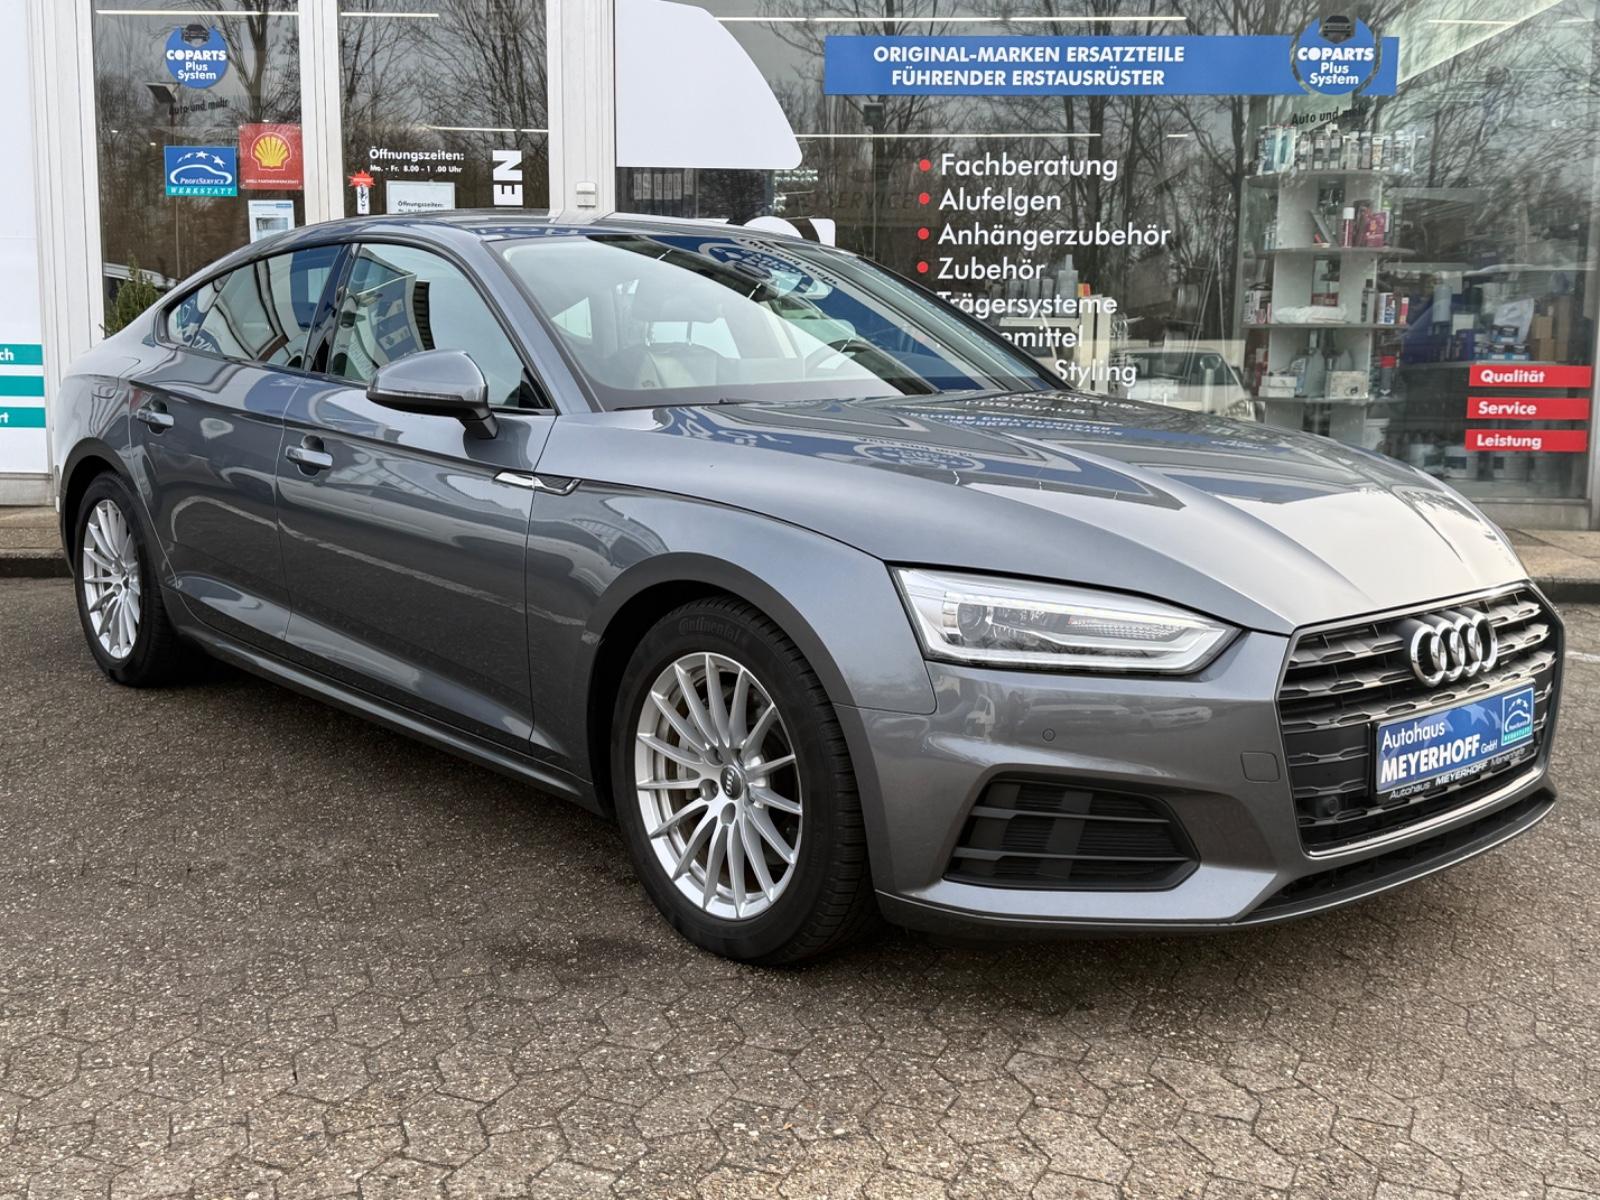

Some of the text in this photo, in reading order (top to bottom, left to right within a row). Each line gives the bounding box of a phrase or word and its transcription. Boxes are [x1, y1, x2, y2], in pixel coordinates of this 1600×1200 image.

[166, 49, 227, 61] COPARTS
[873, 46, 1185, 63] ORIGINAL-MARKEN ERSATZTEILE
[1297, 47, 1375, 61] COPARTS
[185, 61, 208, 71] Plus
[1320, 62, 1349, 73] Plus
[177, 69, 216, 82] System
[892, 66, 1165, 86] FÜHRENDER ERSTAUSRÜSTER
[1309, 72, 1359, 87] System
[1291, 112, 1316, 125] Auto
[369, 146, 465, 163] Öffnungszeiten:
[940, 152, 1118, 179] Fachberatung
[938, 187, 1062, 212] Alufelgen
[937, 222, 1172, 249] Anhängerzubehör
[937, 257, 1046, 281] Zubehör
[1480, 370, 1546, 384] Qualität
[1478, 401, 1537, 415] Service
[1476, 433, 1543, 450] Leistung
[1382, 722, 1445, 750] Autohaus
[1381, 734, 1480, 783] MEYERHOFF
[1481, 739, 1498, 754] GmbH
[1390, 762, 1488, 800] Autohaus MEYERHOFF
